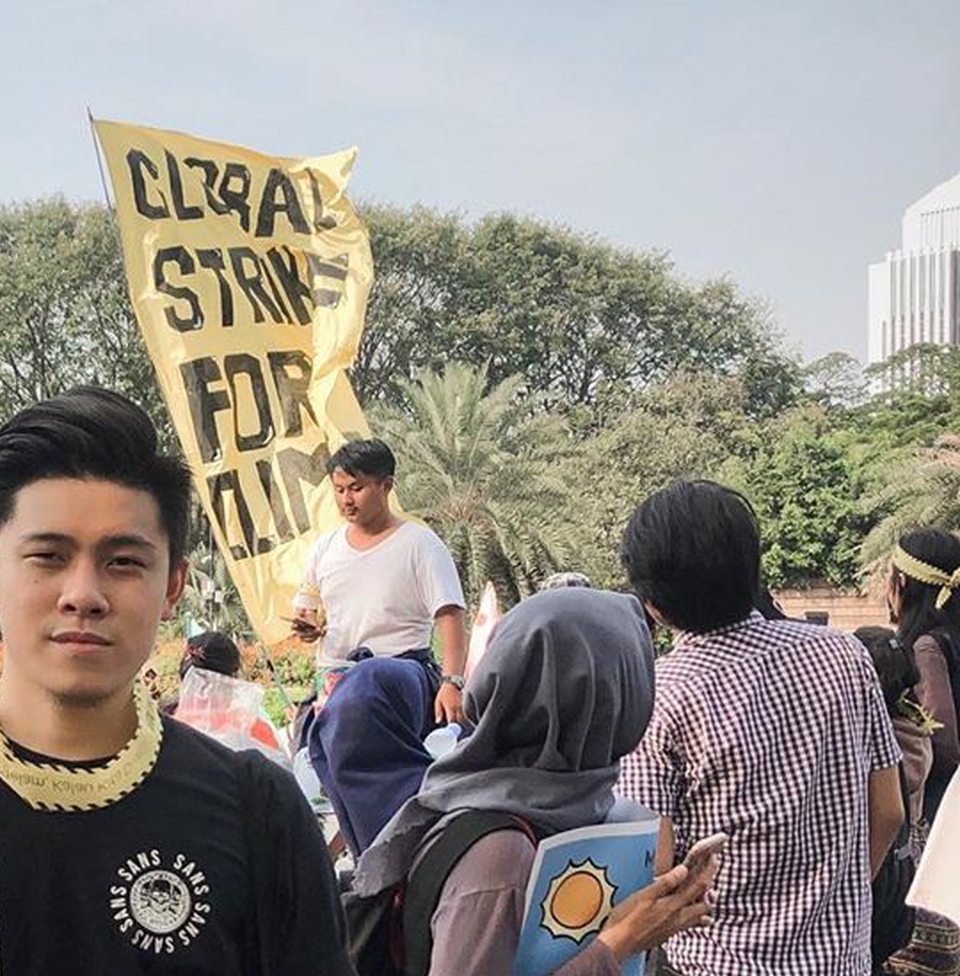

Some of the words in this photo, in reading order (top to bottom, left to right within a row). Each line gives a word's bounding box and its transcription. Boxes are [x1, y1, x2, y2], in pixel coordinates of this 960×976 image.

[180, 350, 319, 464] FOR
[118, 849, 161, 882] SANS
[173, 854, 210, 895] SANS
[109, 885, 134, 933] SANS
[178, 902, 211, 946] SANS
[131, 929, 175, 954] SANS
